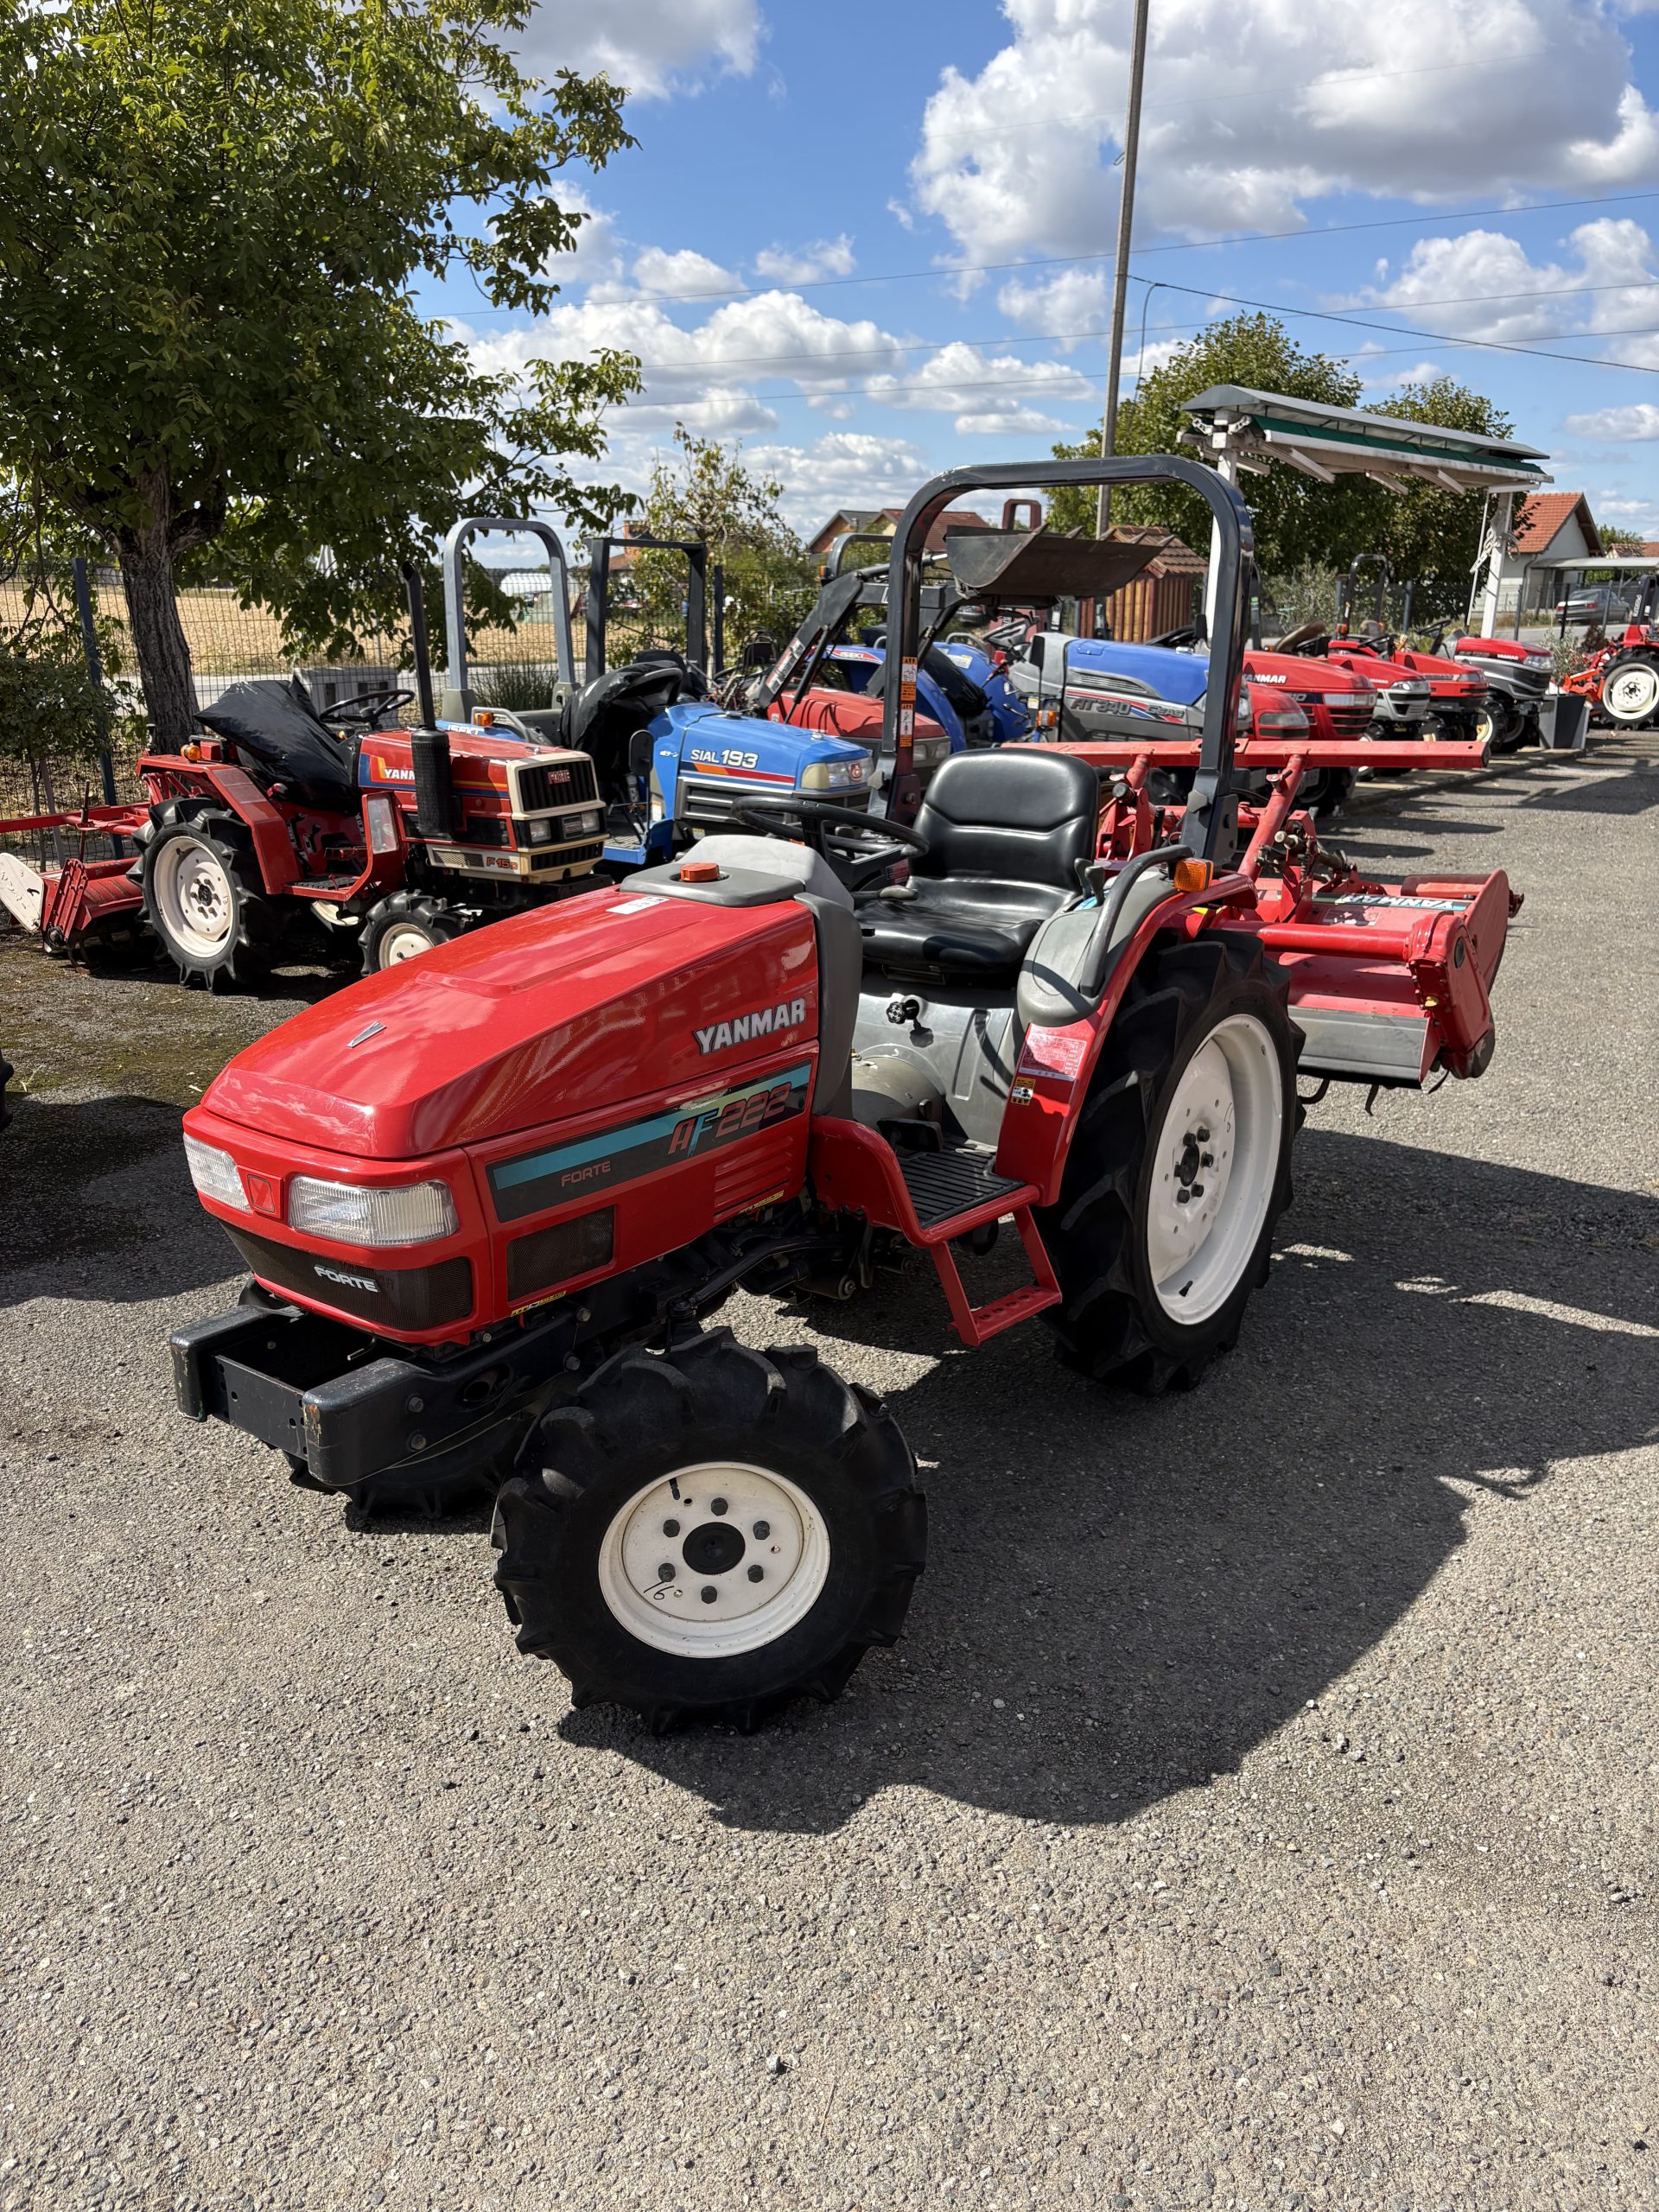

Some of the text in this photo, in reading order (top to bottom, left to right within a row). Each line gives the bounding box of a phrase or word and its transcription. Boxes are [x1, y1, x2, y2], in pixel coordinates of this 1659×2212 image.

[690, 748, 759, 769] SIAL 193
[1337, 893, 1453, 910] YANMAR
[695, 997, 806, 1056] YANMAR
[668, 1081, 791, 1157] AF222
[560, 1160, 612, 1187] FORTE
[313, 1263, 380, 1294] FORTE
